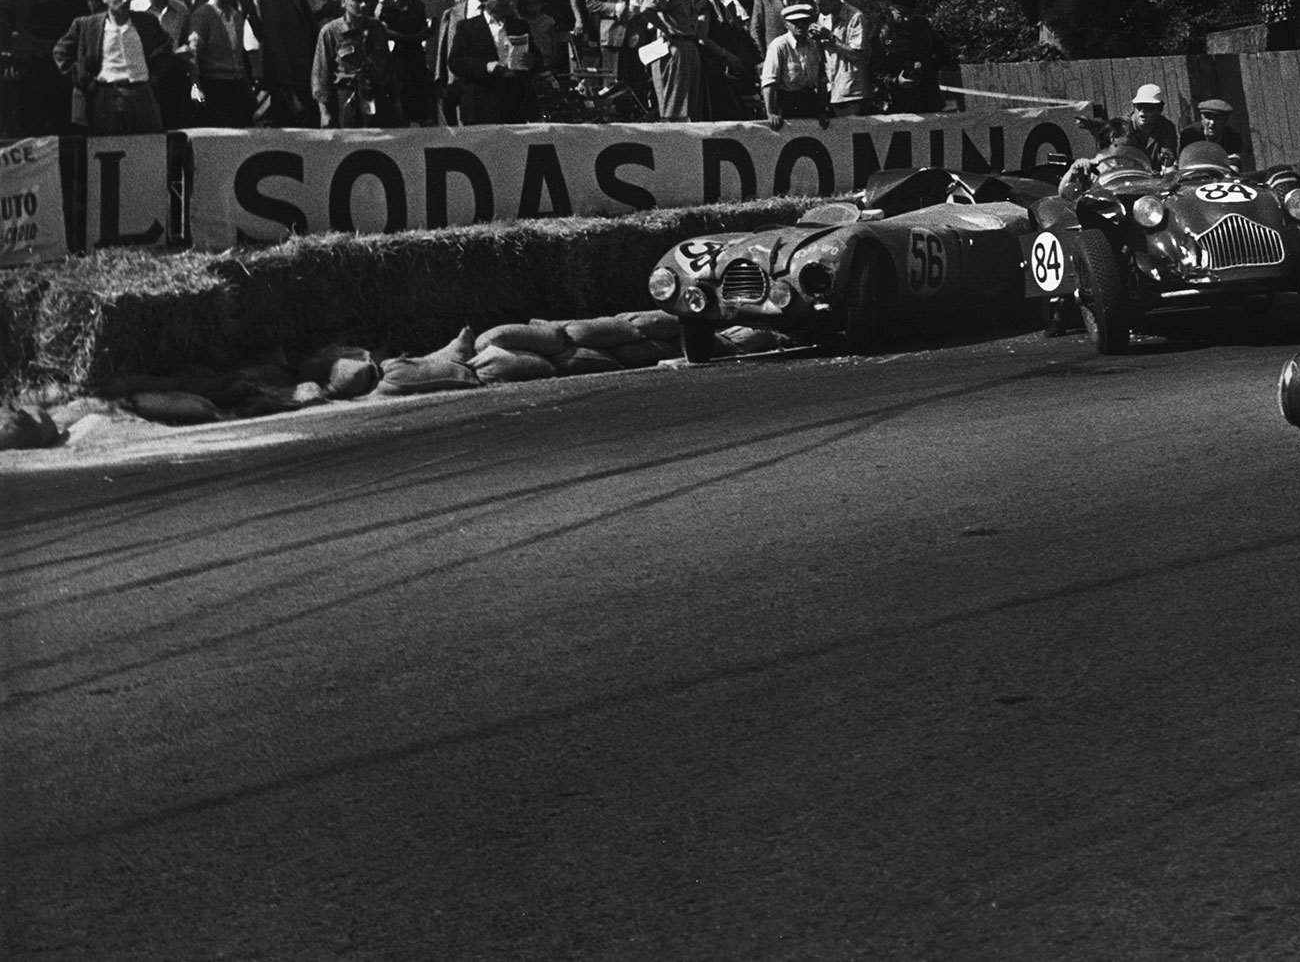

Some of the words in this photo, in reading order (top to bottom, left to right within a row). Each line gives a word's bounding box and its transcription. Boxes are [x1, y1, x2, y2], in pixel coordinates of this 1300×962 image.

[94, 150, 164, 246] L
[233, 142, 657, 245] SODAS
[702, 122, 1073, 204] DOMINO
[1199, 184, 1252, 200] 84
[909, 233, 944, 289] 56
[1034, 240, 1061, 284] 84
